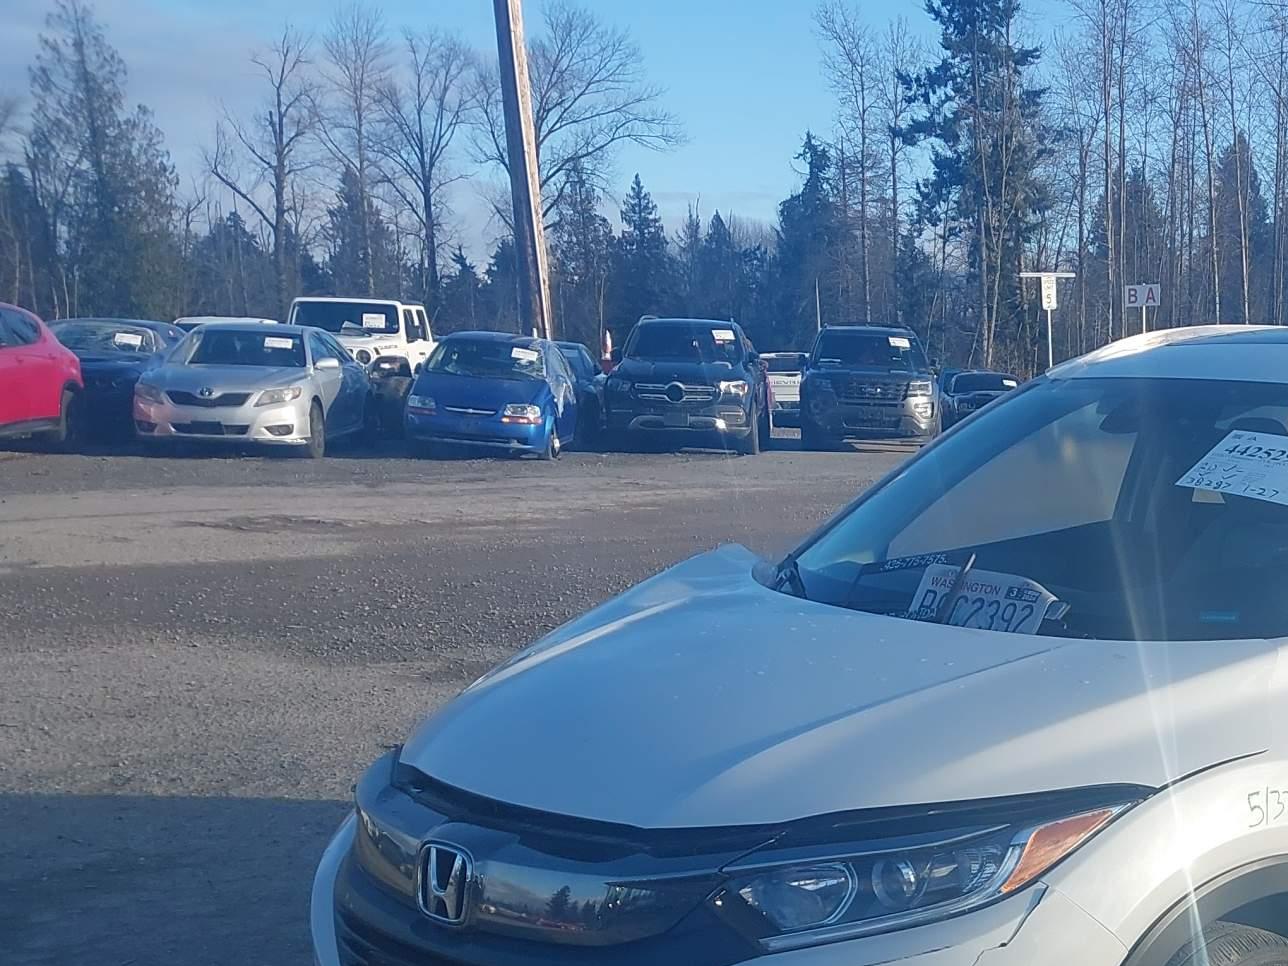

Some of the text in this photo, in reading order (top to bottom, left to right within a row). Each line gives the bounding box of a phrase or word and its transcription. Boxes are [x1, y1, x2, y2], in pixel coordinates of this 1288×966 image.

[1127, 287, 1156, 304] B A
[931, 576, 1001, 595] WASINGTON
